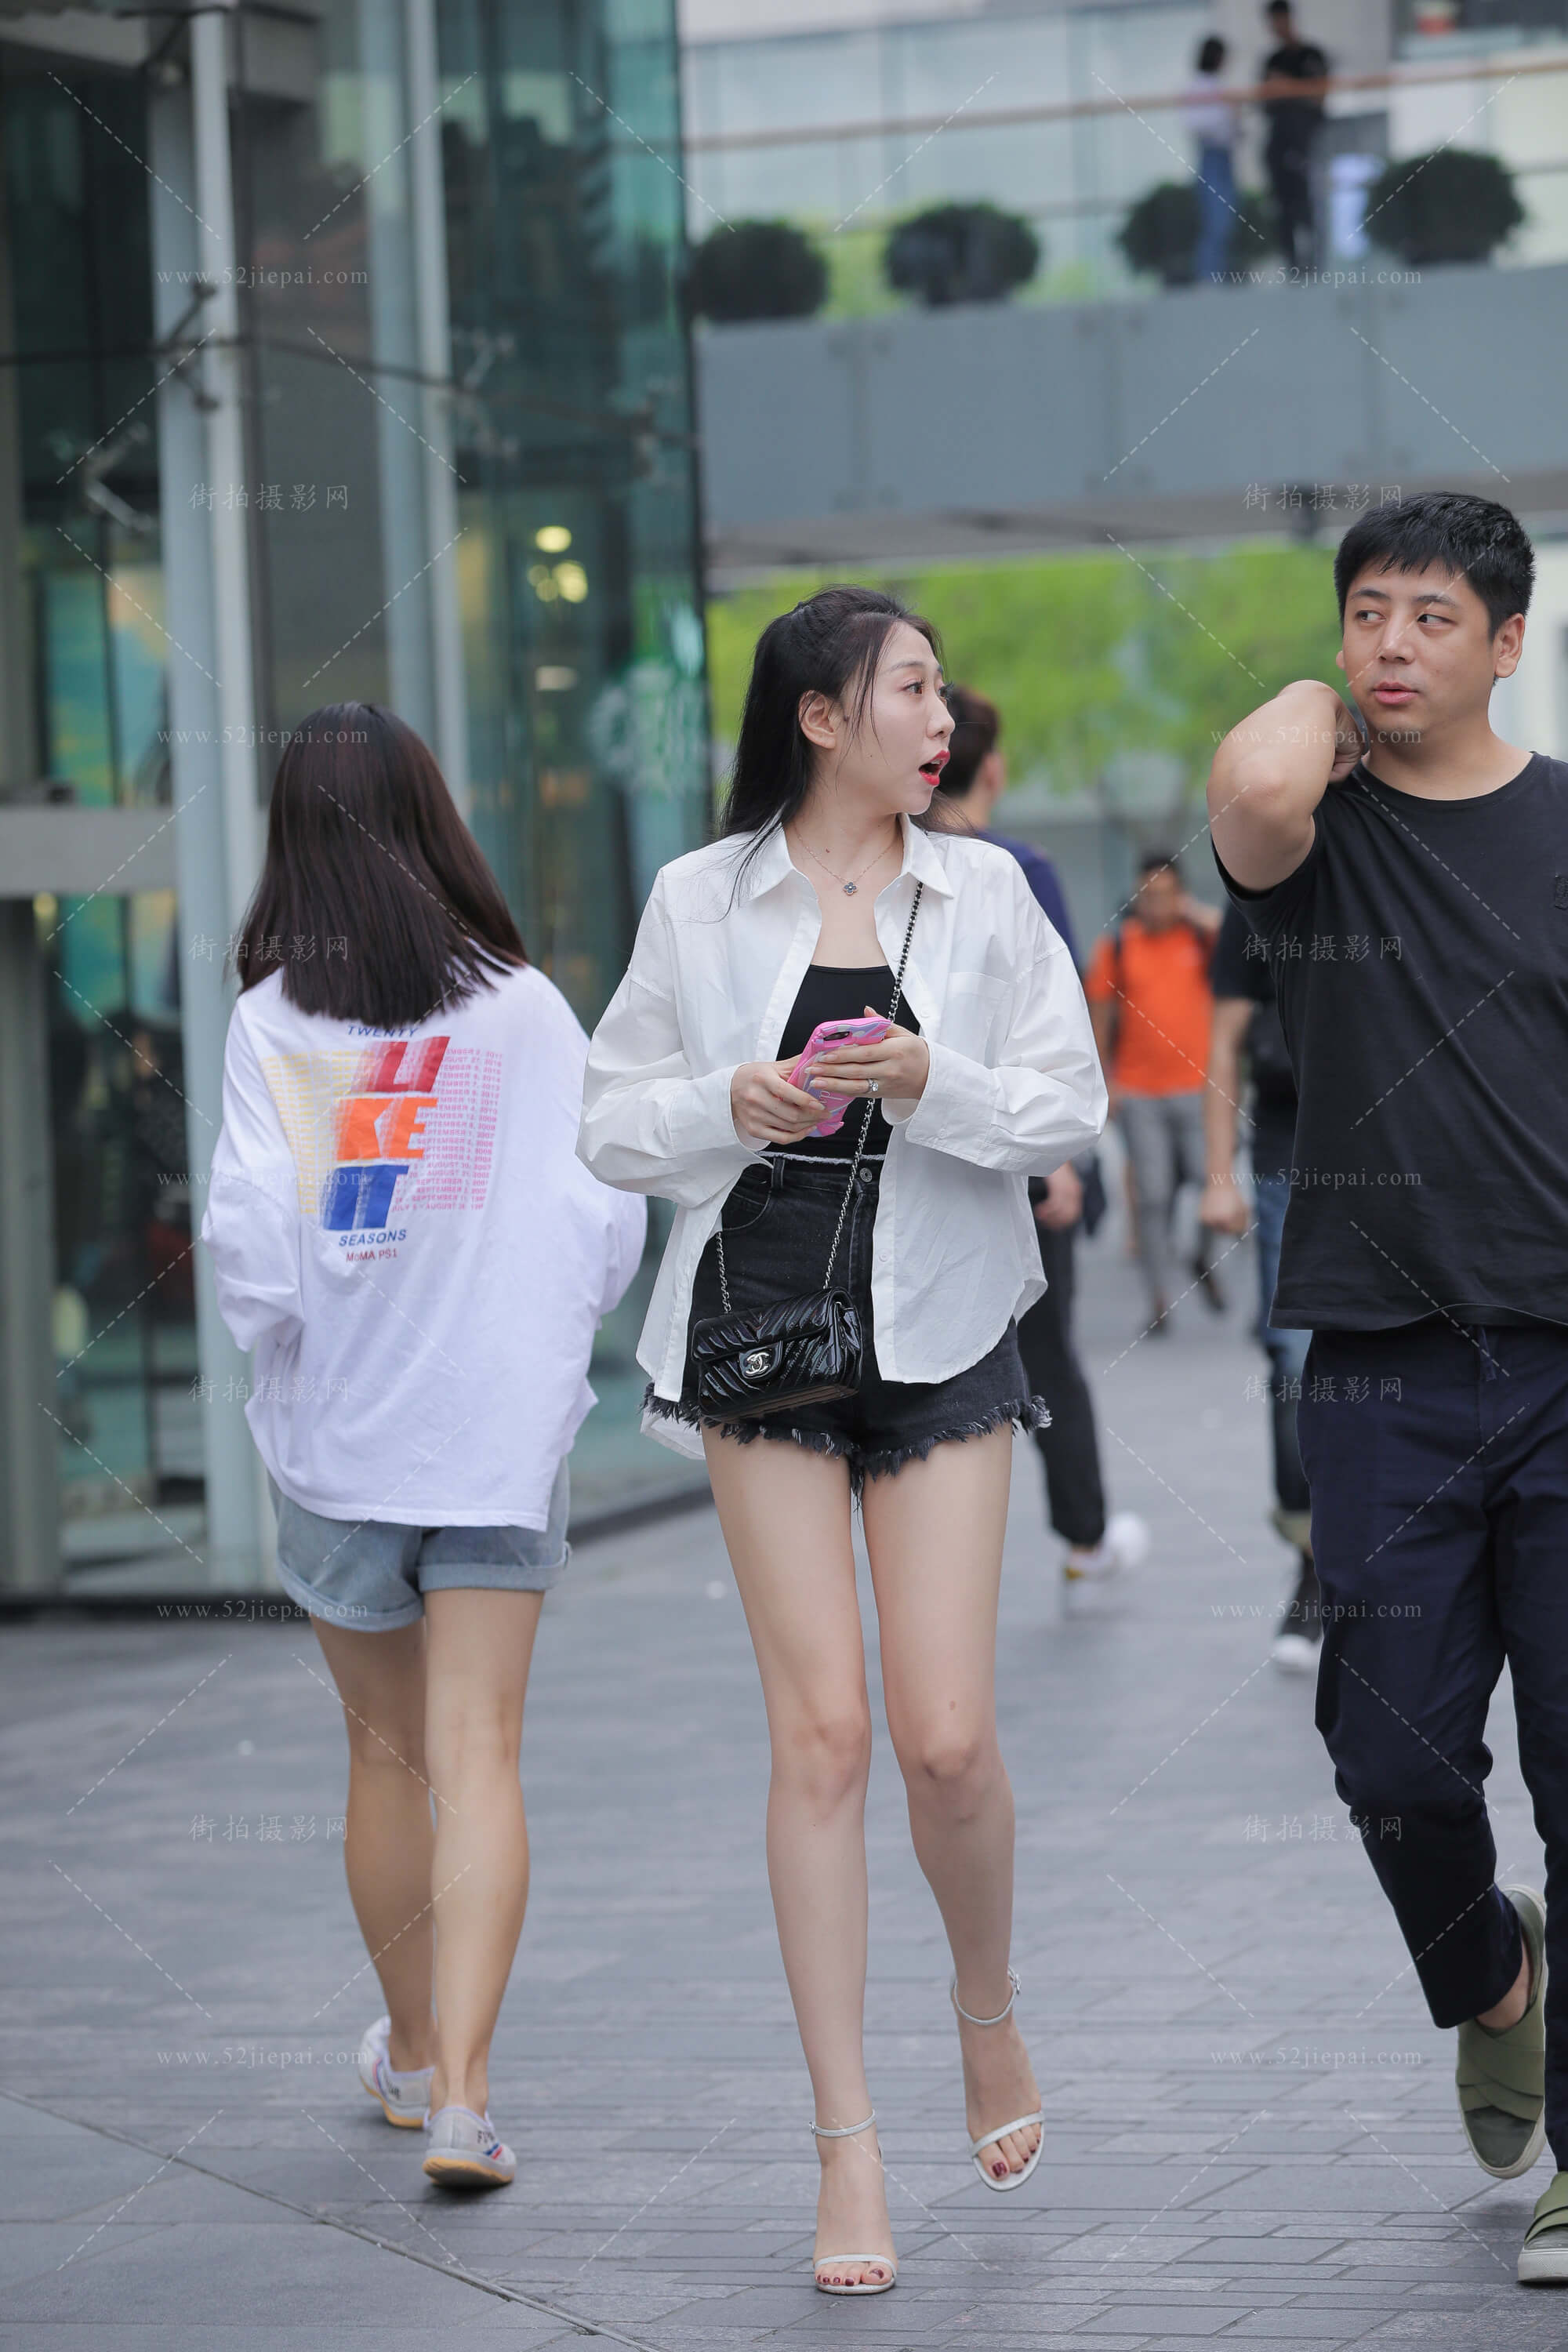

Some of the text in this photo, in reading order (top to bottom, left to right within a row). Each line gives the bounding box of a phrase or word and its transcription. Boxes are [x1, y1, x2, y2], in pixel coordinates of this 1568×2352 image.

[347, 1025, 418, 1037] TWENTY
[339, 1229, 406, 1247] SEASONS
[346, 1247, 397, 1263] MoMA PS1
